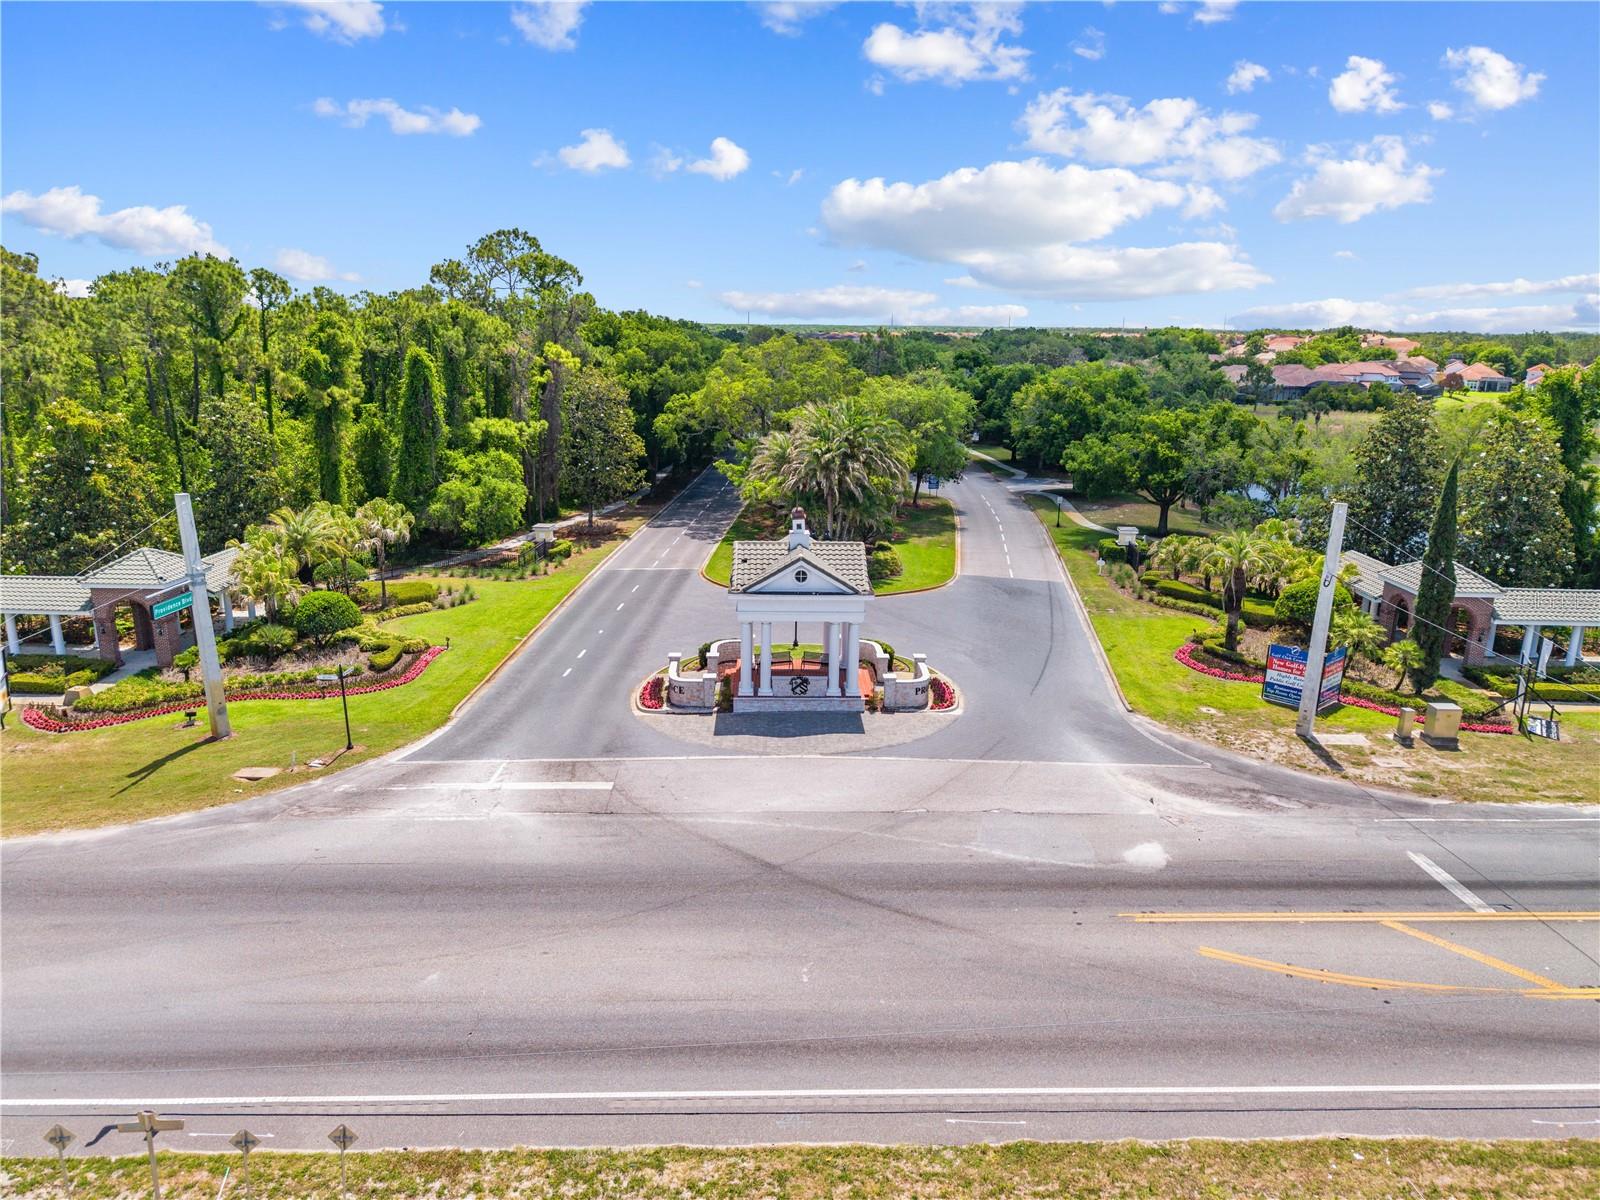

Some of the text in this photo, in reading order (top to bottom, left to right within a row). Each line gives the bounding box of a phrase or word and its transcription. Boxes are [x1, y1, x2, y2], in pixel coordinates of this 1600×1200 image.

[154, 601, 181, 617] Providence
[1272, 658, 1284, 666] New
[1272, 664, 1292, 674] Homes
[1292, 667, 1302, 675] for
